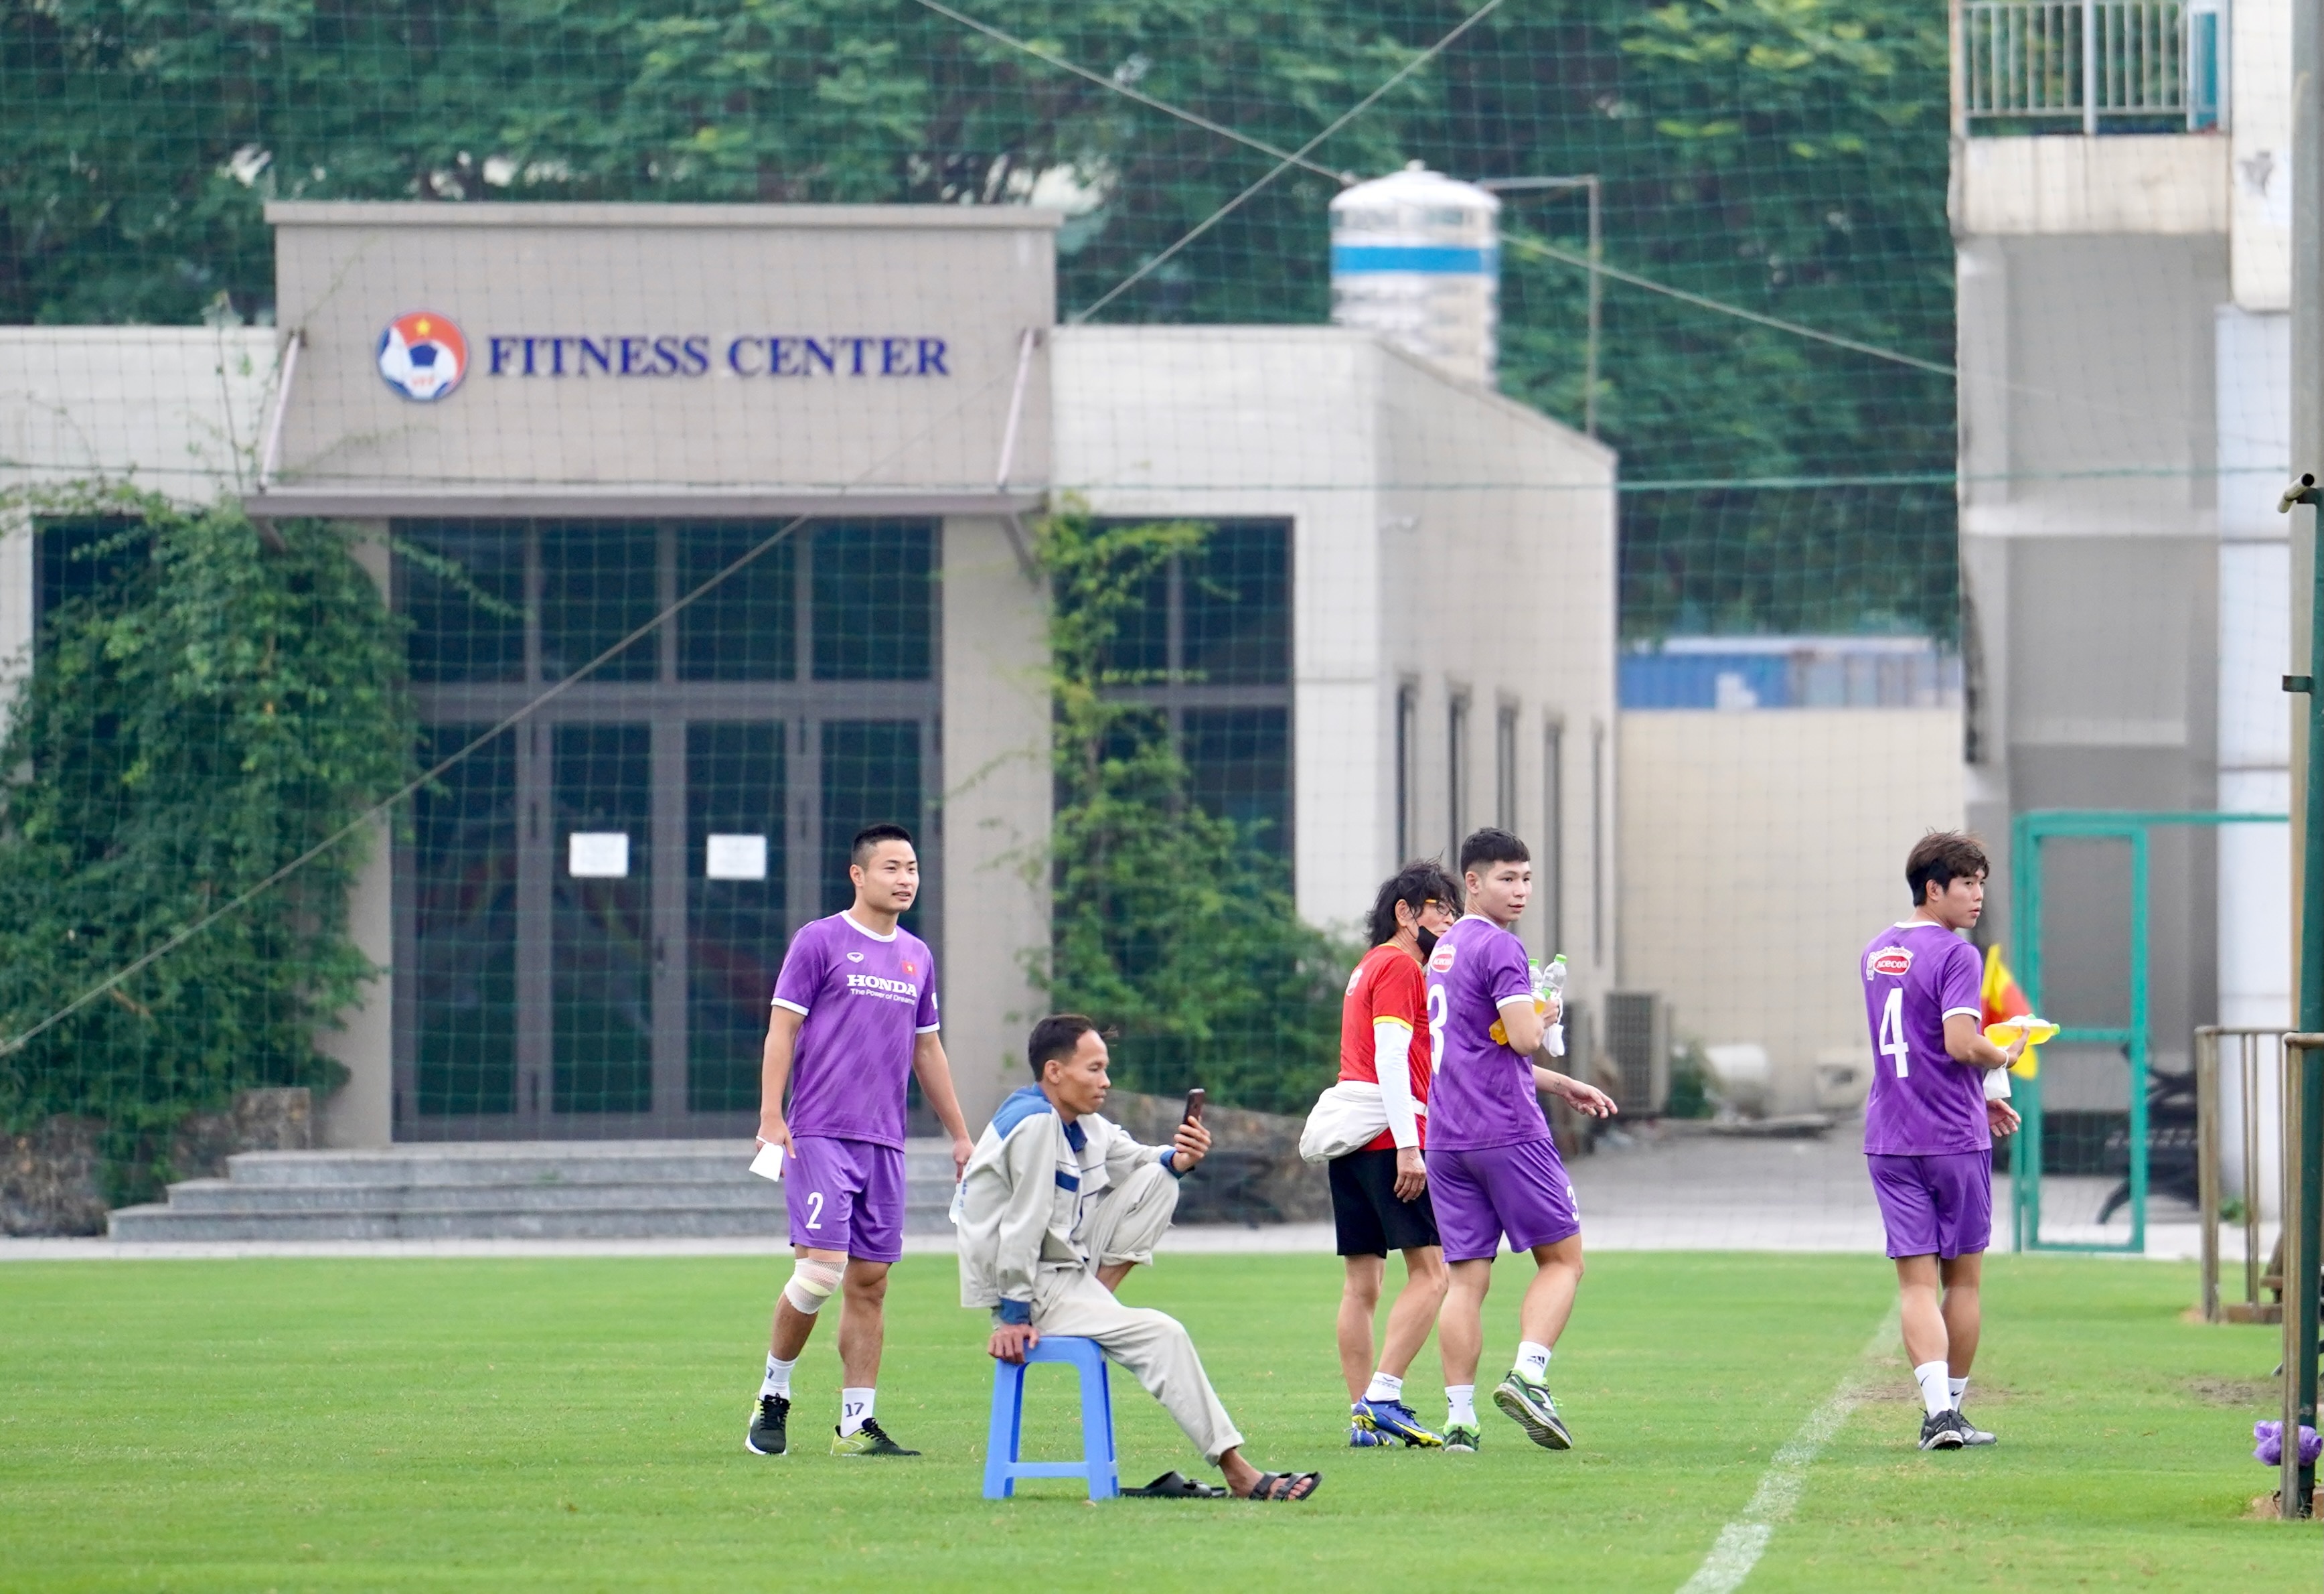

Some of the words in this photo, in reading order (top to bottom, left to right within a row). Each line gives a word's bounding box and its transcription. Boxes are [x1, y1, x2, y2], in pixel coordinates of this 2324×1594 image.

[488, 334, 709, 377] FITNESS
[728, 334, 949, 377] CENTER
[846, 974, 917, 997] HONDA
[850, 988, 865, 996] The
[866, 989, 885, 999] Power
[893, 995, 915, 1005] Dreams
[1879, 987, 1909, 1078] 4
[805, 1191, 824, 1230] 2
[845, 1401, 864, 1418] 17
